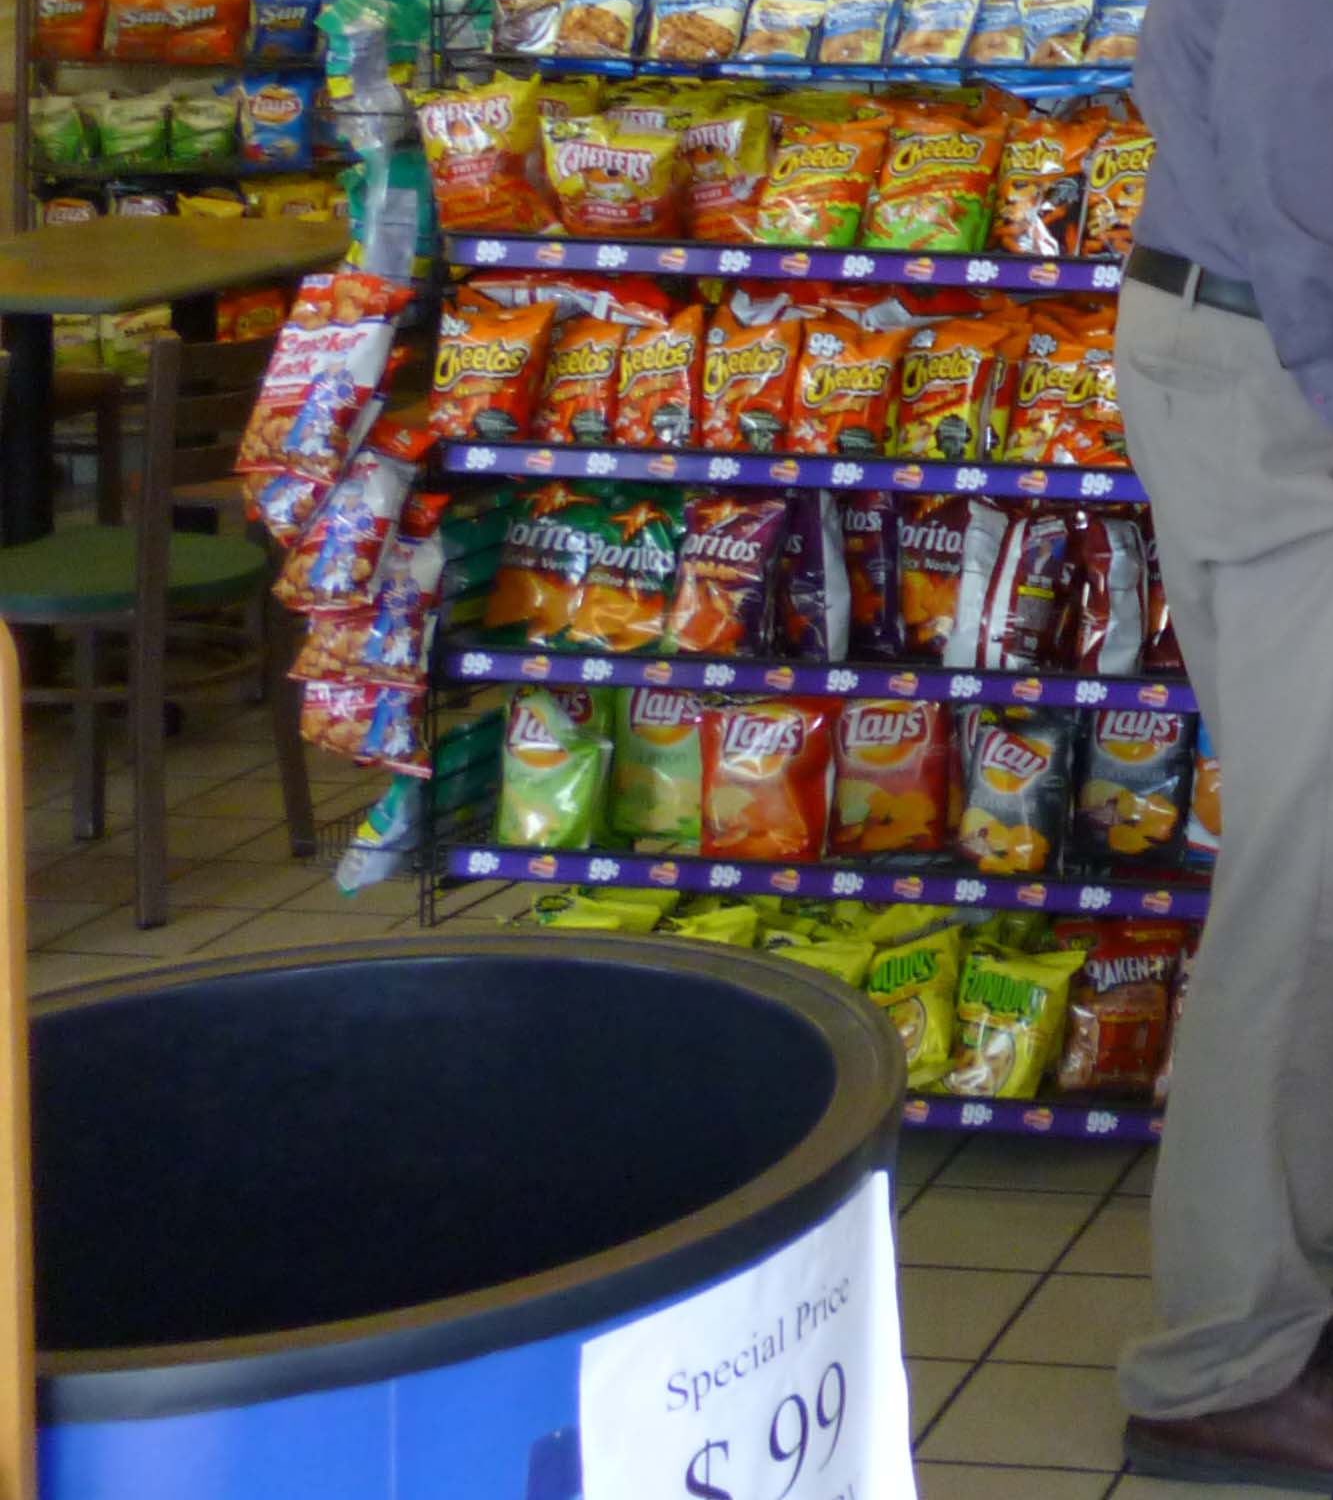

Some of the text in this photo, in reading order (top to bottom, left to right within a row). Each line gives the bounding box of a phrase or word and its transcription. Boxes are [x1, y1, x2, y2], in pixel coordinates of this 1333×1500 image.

[891, 136, 983, 175] Cheetos
[1090, 141, 1155, 188] Cheet
[433, 341, 525, 388] Cheetos
[846, 705, 924, 747] Lay's
[665, 1277, 850, 1413] Special Price
